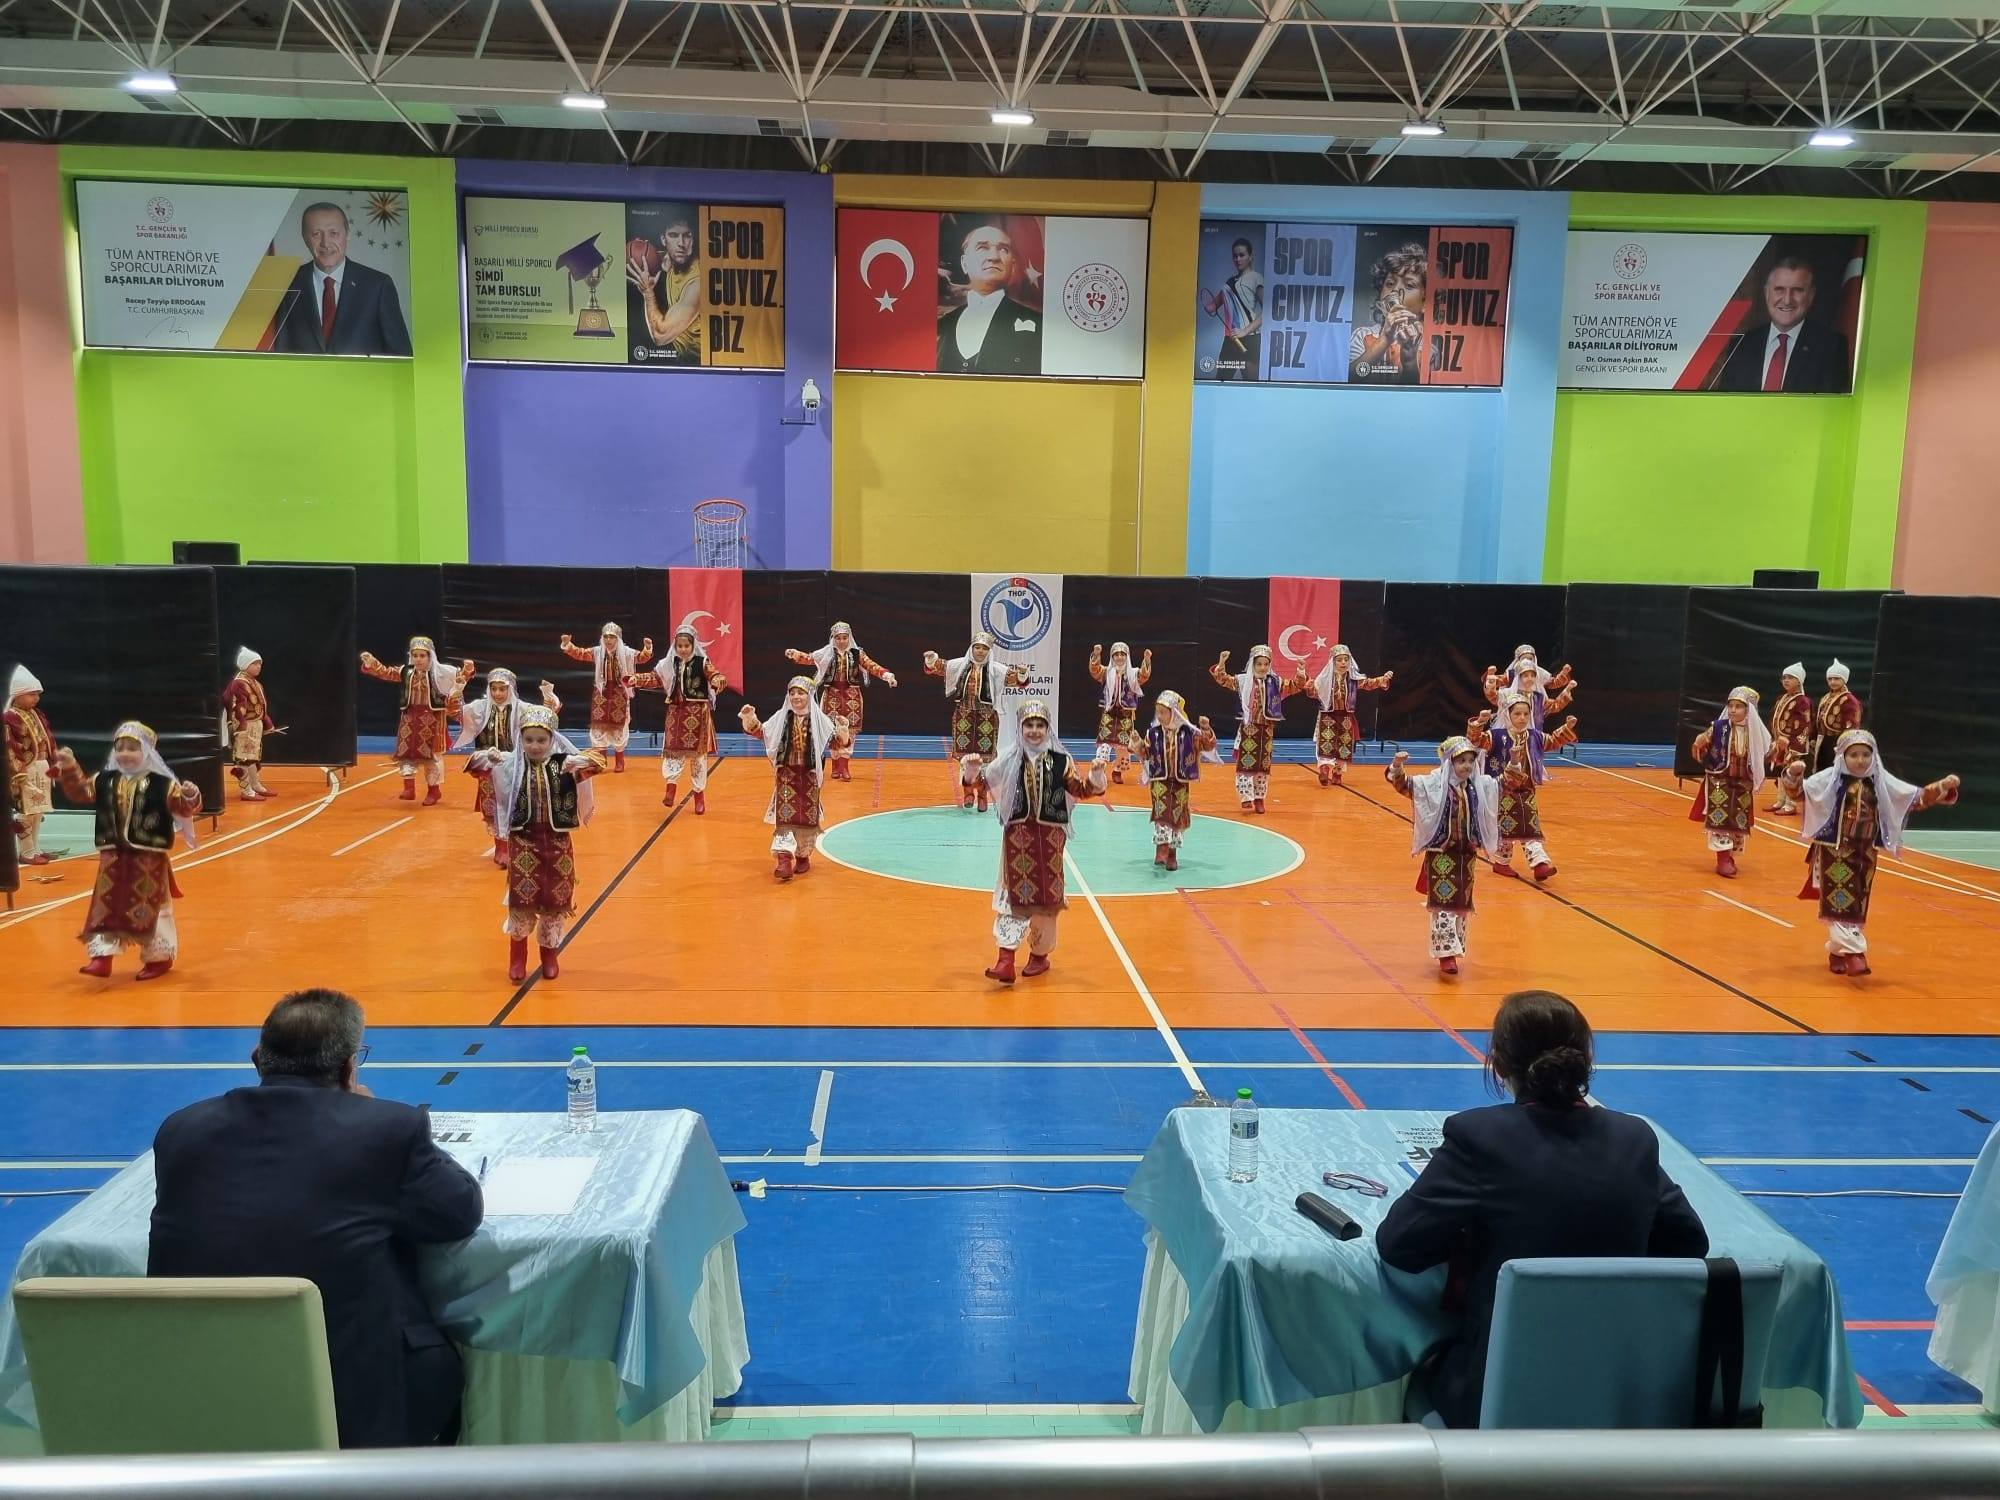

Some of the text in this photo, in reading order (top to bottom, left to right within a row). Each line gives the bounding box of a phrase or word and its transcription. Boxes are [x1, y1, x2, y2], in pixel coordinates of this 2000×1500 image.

[708, 220, 764, 260] SPOR
[105, 247, 220, 263] TÜM ANTRENÖR VE
[1273, 237, 1333, 277] SPOR
[1436, 241, 1490, 280] SPOR
[110, 261, 217, 275] SPORCULARIMIZA
[525, 258, 552, 268] SPORCU
[104, 275, 224, 288] BAŞARILAR DİLİYORUM
[475, 269, 504, 283] ŞİMDİ
[475, 285, 541, 297] TAM BURSLU!
[1595, 283, 1610, 291] T.C.
[1612, 282, 1648, 293] GENÇLİK
[171, 298, 206, 306] ERDOĞAN
[1594, 292, 1660, 301] SPOR BAKANLIĞI
[141, 307, 205, 315] CUMHURBAŞKANI
[1573, 314, 1677, 328] TÜM ANTRENÖR VE
[709, 311, 745, 353] BİZ
[1575, 328, 1673, 340] SPORCULARIMIZA
[1270, 327, 1307, 369] BİZ
[1568, 341, 1678, 352] BAŞARILAR DİLİYORUM
[1622, 356, 1642, 365] Aşkın
[1575, 364, 1667, 374] GENÇLİK VE SPOR BAKANI
[1001, 688, 1050, 696] RASYONU
